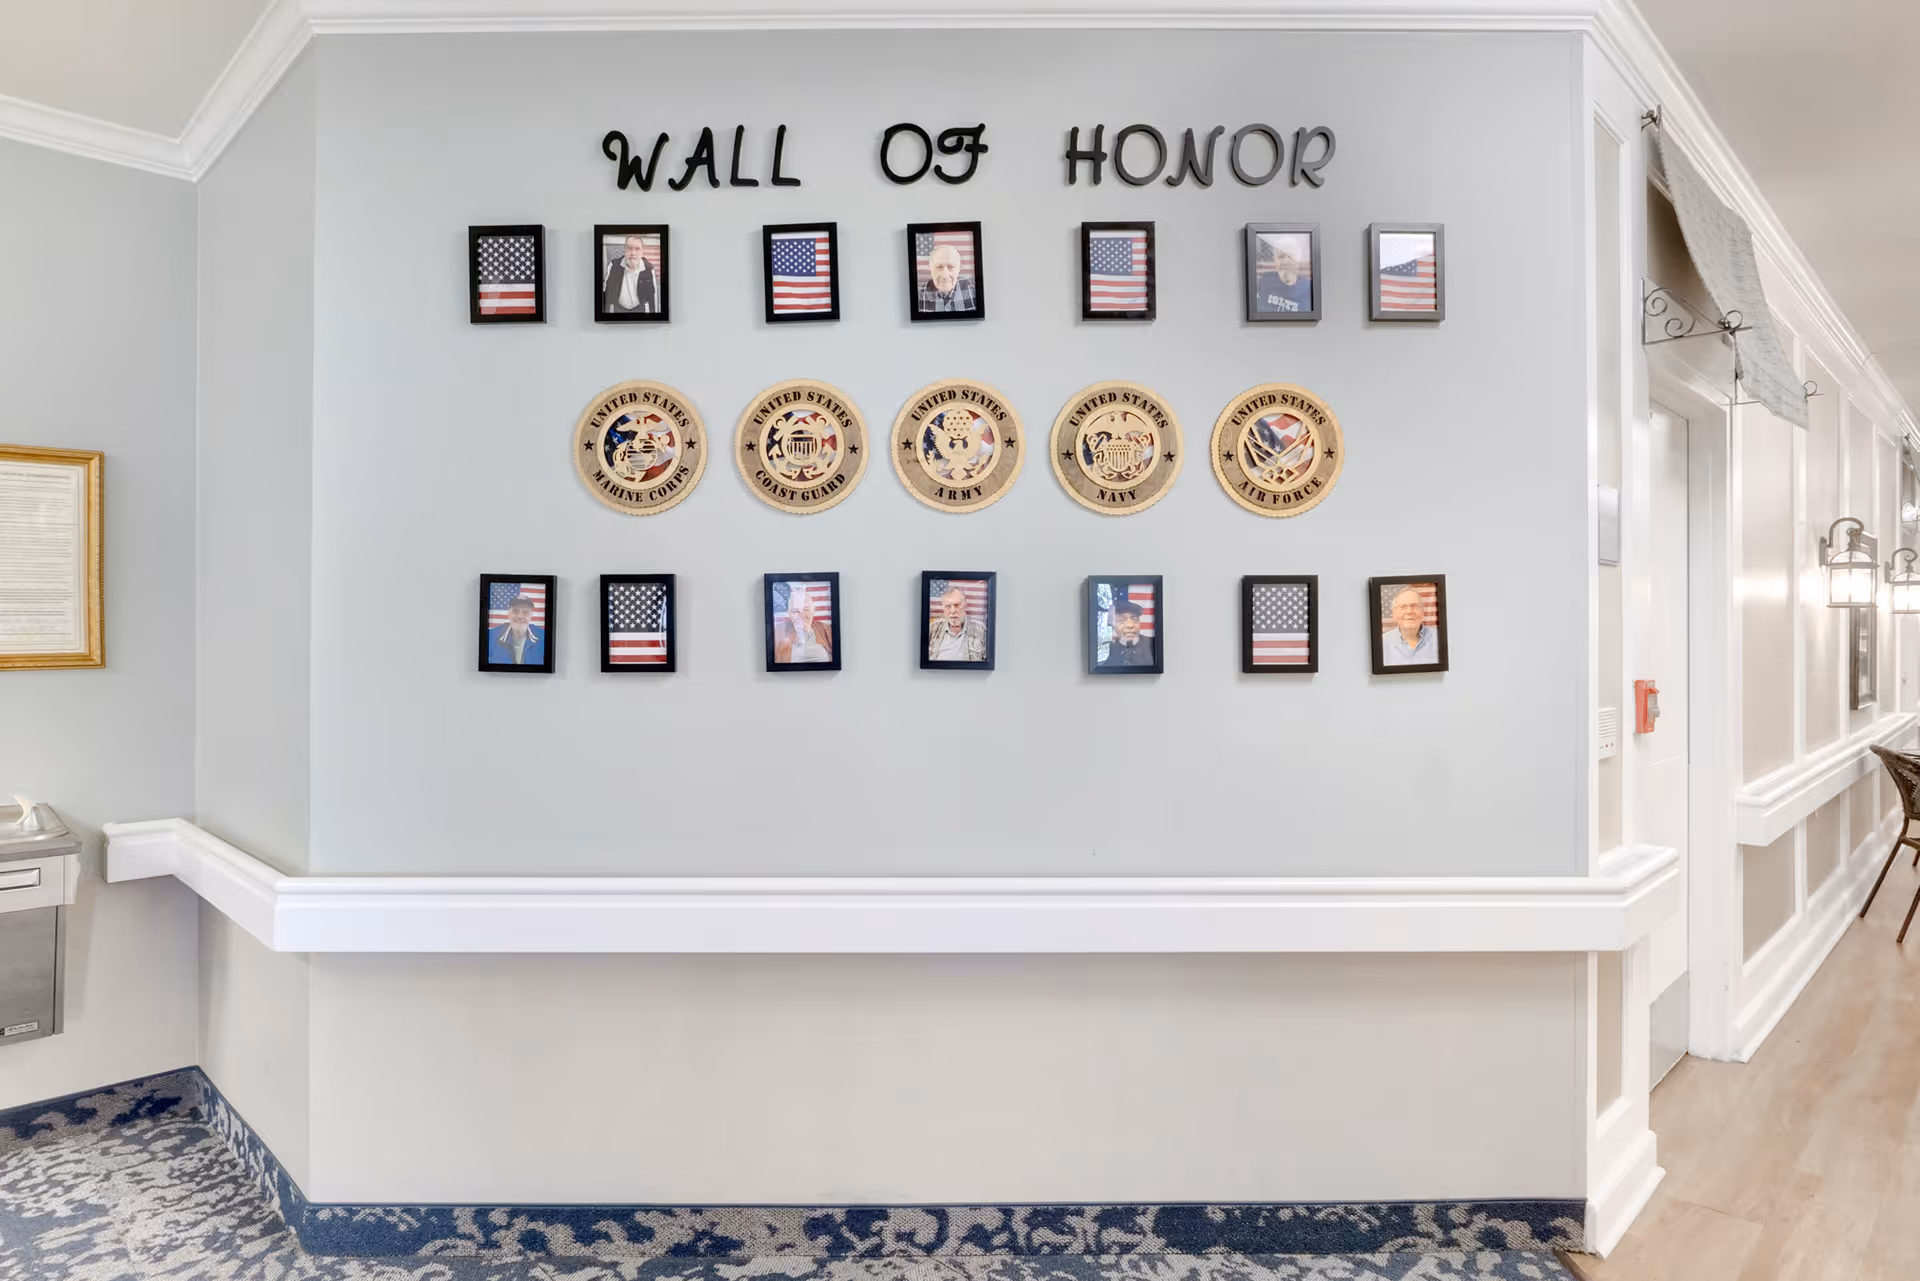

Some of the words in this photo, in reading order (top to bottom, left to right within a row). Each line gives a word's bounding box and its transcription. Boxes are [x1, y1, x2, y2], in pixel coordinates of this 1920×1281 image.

[601, 123, 801, 192] WALL
[880, 123, 989, 185] OF
[1064, 123, 1336, 189] HONOR
[590, 392, 638, 429] UNITED
[643, 392, 690, 428] STATES
[753, 391, 802, 426] UNITED
[806, 391, 853, 428] STATES
[910, 389, 957, 422] UNITED
[961, 389, 1007, 422] STATES
[1069, 392, 1117, 428] UNITED
[1121, 392, 1169, 429] STATES
[1231, 394, 1276, 426] UNITED
[1280, 394, 1327, 425] STATES
[592, 469, 643, 502] MARINE
[649, 464, 690, 502] CORPS
[755, 469, 798, 501] COAST
[801, 473, 846, 501] GUARD
[934, 485, 984, 501] ARMY
[1096, 489, 1138, 503] NAVY
[1238, 480, 1266, 503] AIR
[1272, 476, 1322, 505] FORCE
